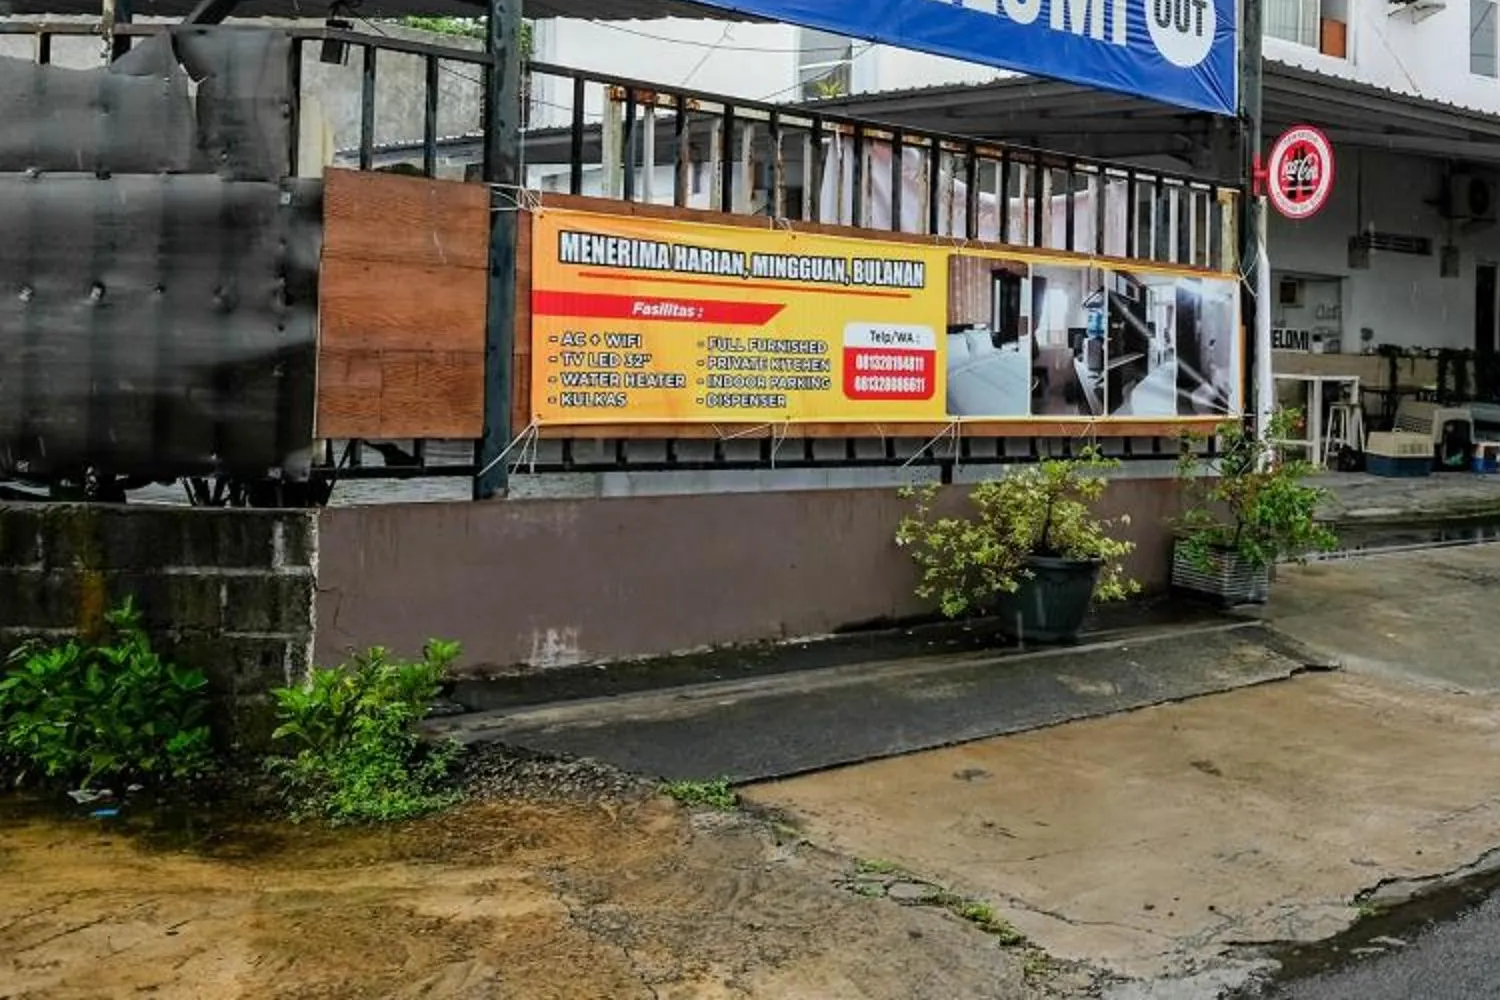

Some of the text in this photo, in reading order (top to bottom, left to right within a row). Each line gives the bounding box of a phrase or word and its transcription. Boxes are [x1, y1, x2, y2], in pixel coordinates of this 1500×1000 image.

[559, 230, 924, 289] MENERIMA HARIAN, MINGGUAN, BULANAN
[561, 331, 586, 346] AC
[604, 333, 642, 348] WIFI
[707, 336, 746, 352] FULL
[748, 338, 829, 354] FURNISHED
[1271, 329, 1309, 350] ELOMI
[560, 352, 584, 367] TV
[587, 352, 622, 368] LED
[707, 356, 768, 371] PRIVATE
[769, 358, 831, 373] KITCHEN
[560, 372, 620, 387] WATER
[623, 372, 686, 388] HEATER
[706, 374, 767, 389] INDOOR
[769, 376, 832, 390] PARKING
[560, 391, 628, 407] KULKAS
[706, 392, 787, 408] DISPENSER
